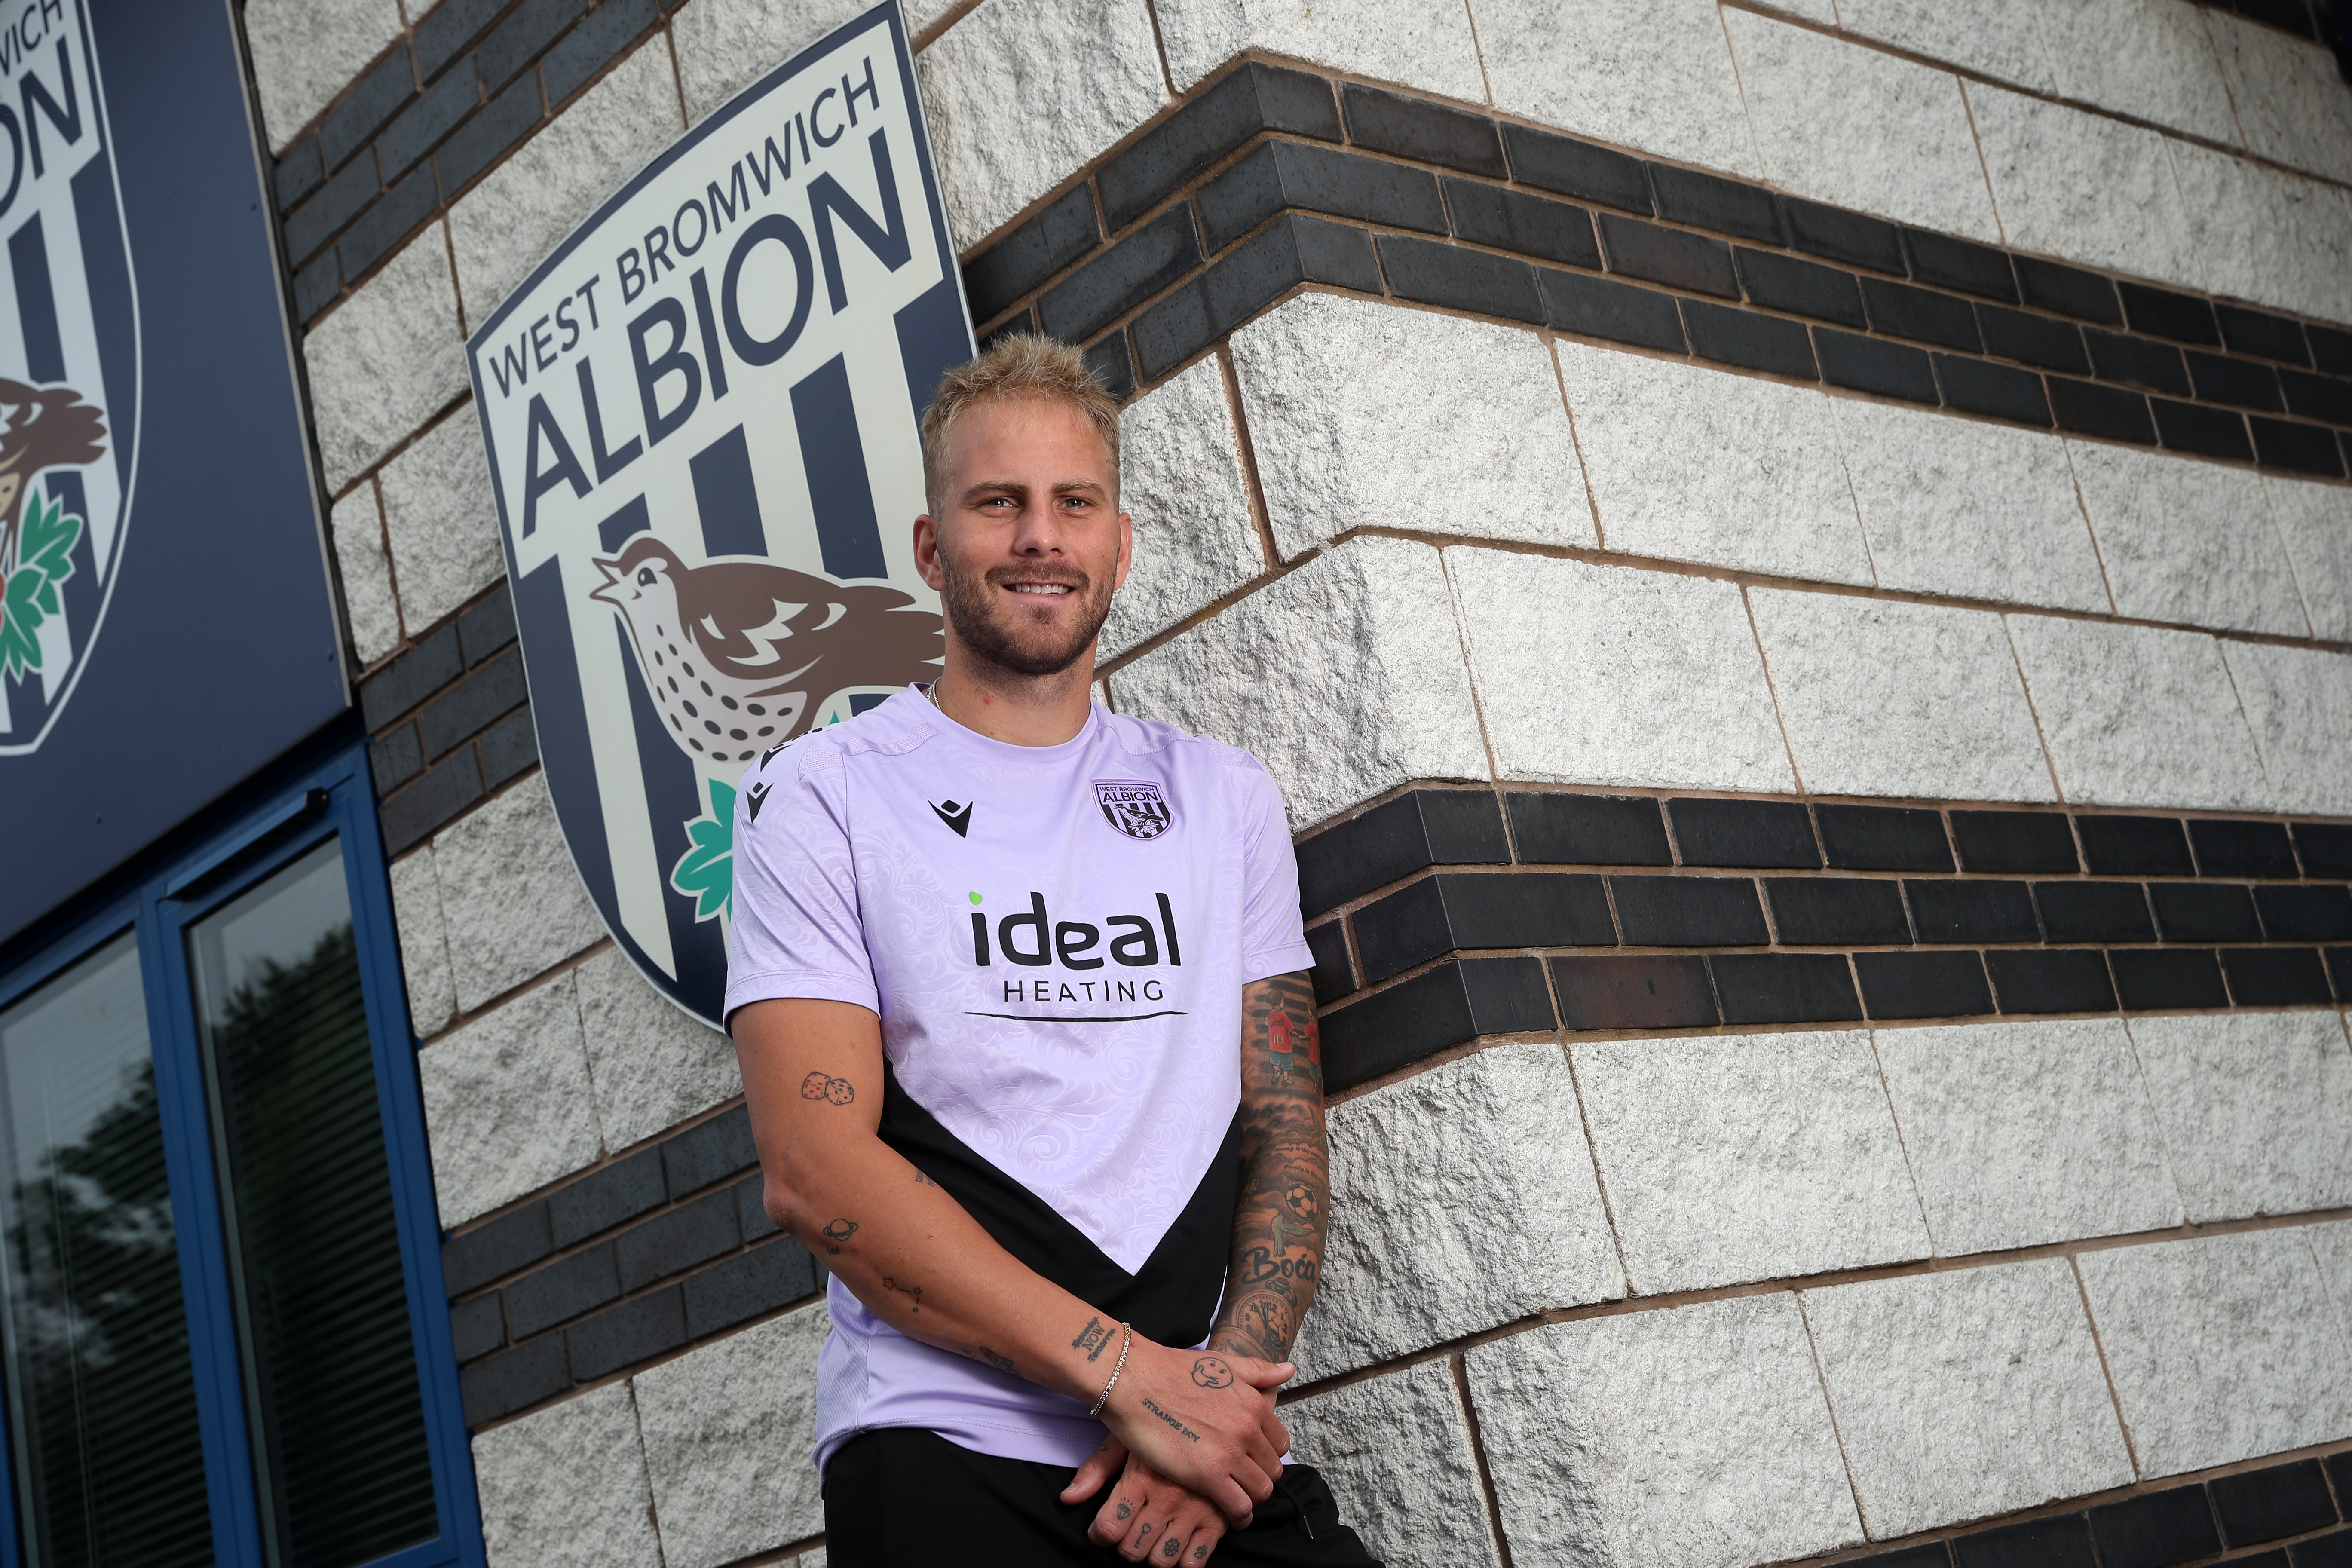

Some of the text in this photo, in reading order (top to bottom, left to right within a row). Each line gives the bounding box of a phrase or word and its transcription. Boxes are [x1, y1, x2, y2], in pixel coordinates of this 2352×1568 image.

[488, 55, 881, 399] WEST BROMWICH
[522, 126, 912, 540] ALBION
[1102, 792, 1158, 802] ALBION
[968, 891, 1181, 970] ideal
[1004, 980, 1164, 1002] HEATING
[1274, 1034, 1283, 1045] 10
[1082, 1325, 1105, 1351] NOW
[1142, 1398, 1200, 1442] STRANGE BOY
